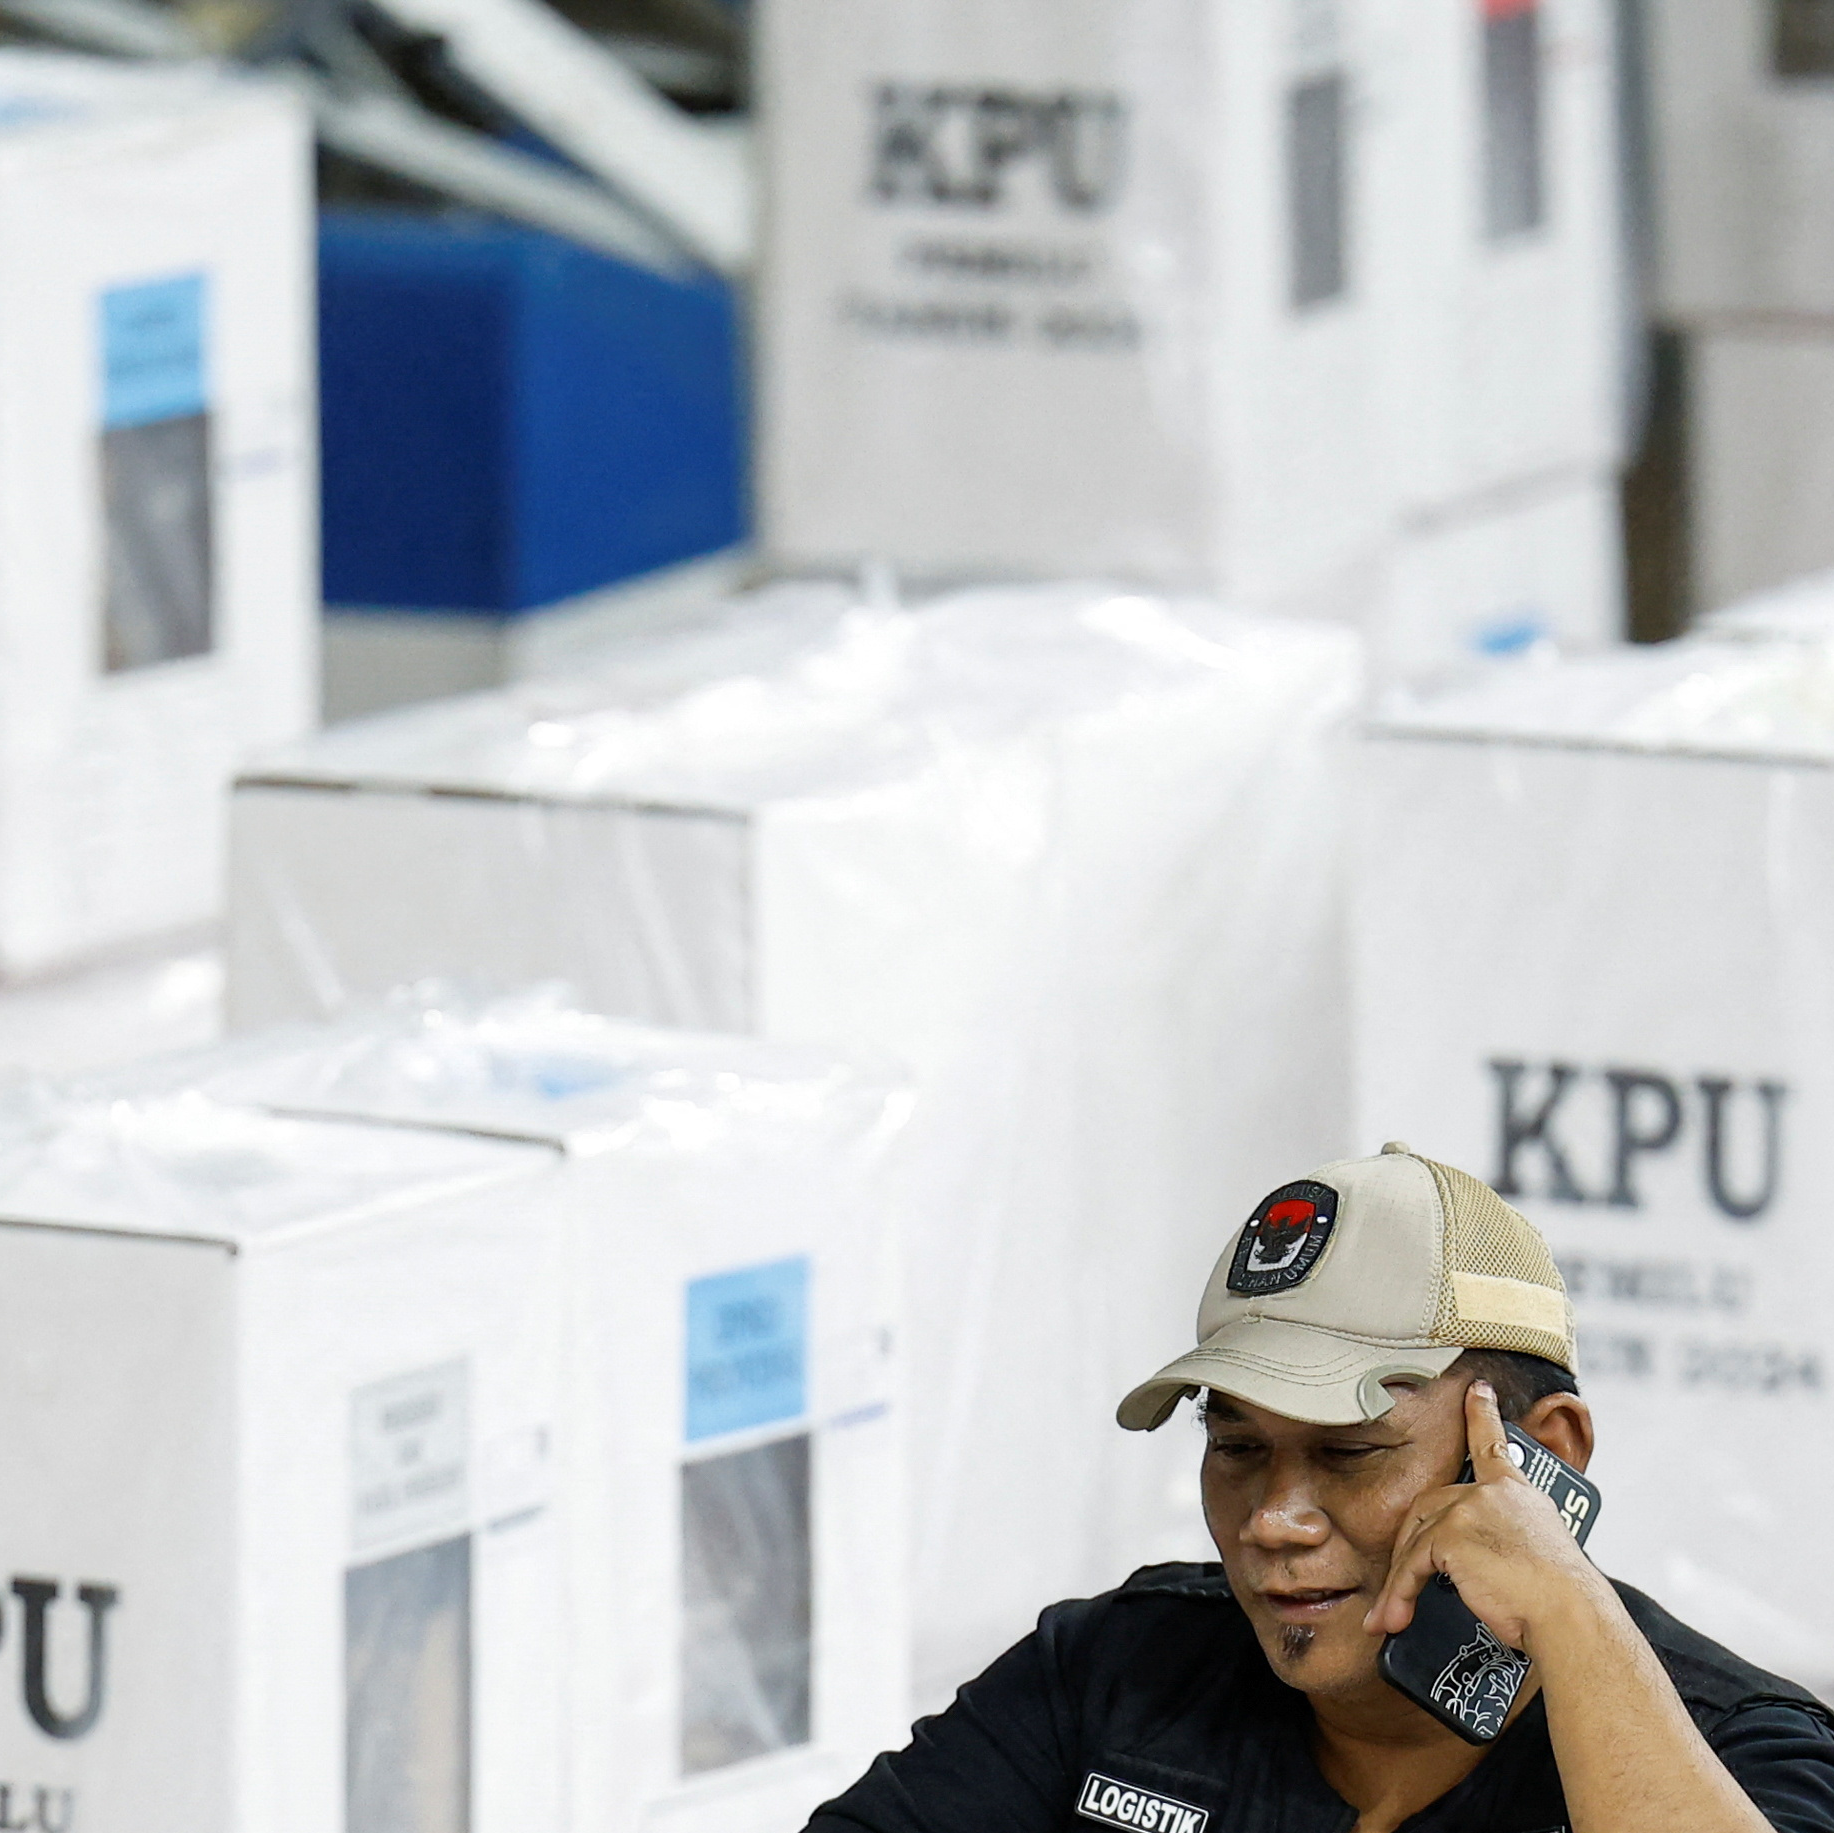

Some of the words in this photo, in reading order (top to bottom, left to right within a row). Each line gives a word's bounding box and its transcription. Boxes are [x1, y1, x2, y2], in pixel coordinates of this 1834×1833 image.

[871, 86, 1129, 212] KPU
[1493, 1060, 1789, 1220] KPU
[1559, 1255, 1750, 1316] EMILU
